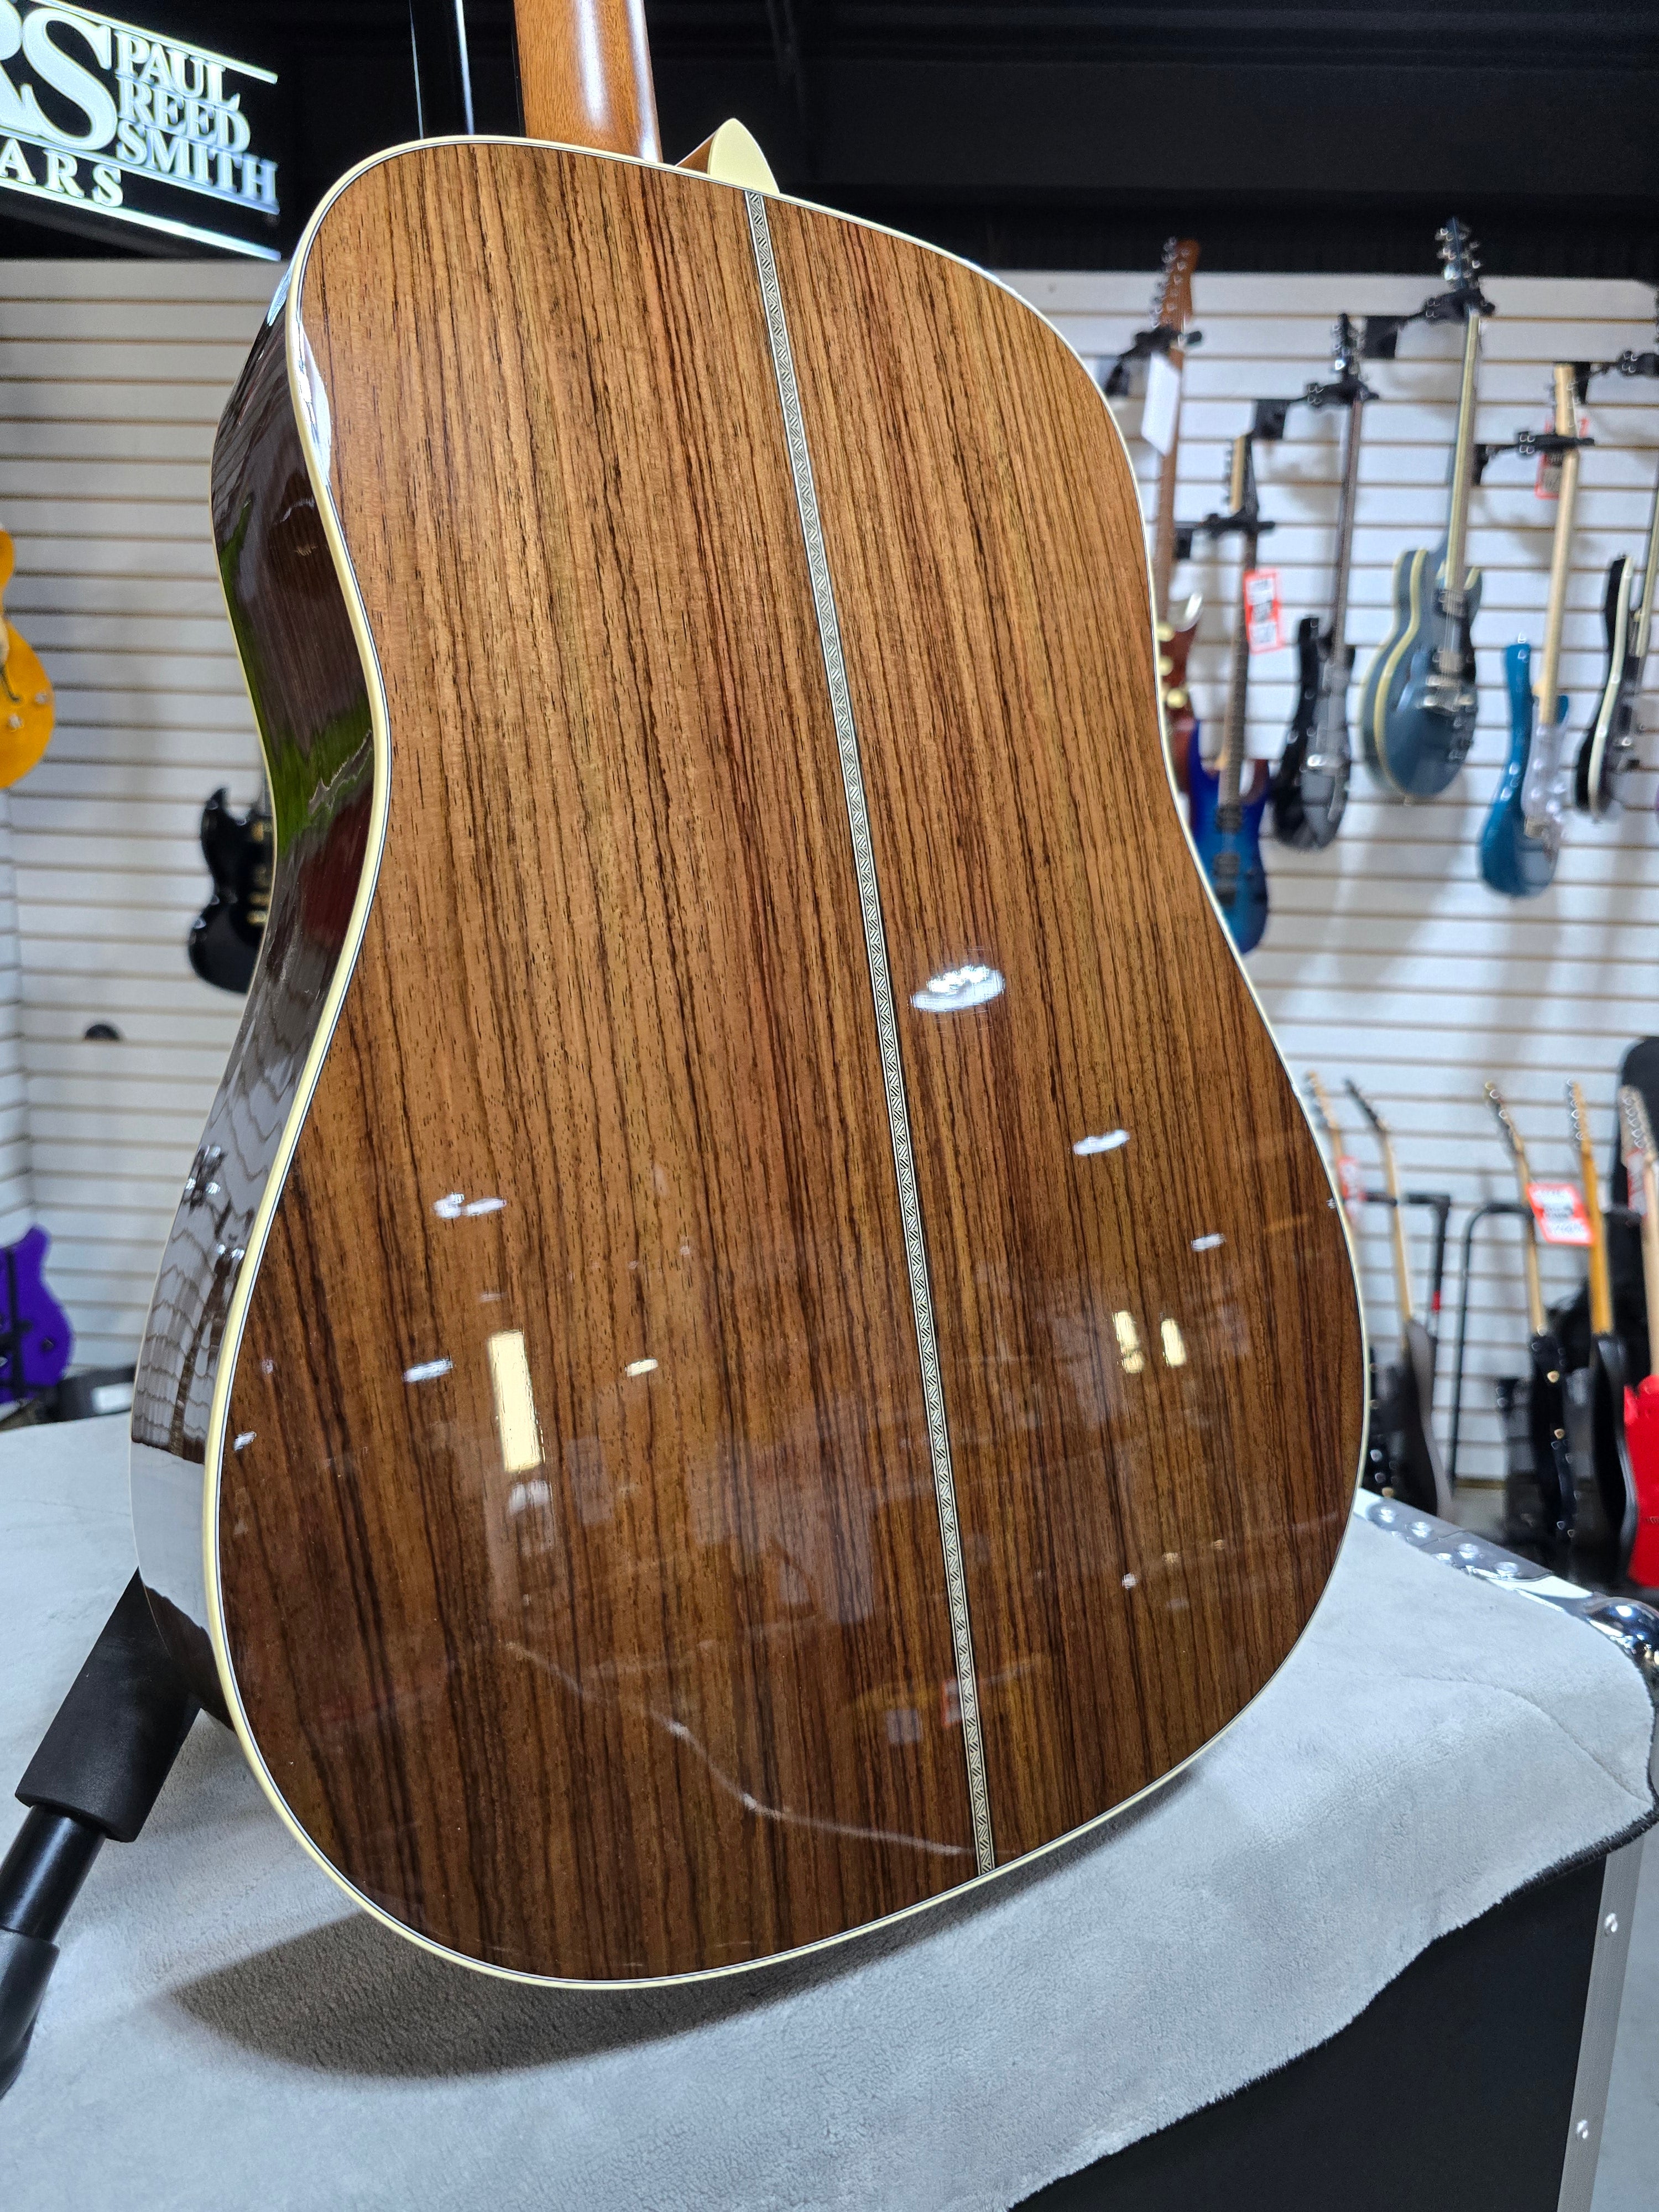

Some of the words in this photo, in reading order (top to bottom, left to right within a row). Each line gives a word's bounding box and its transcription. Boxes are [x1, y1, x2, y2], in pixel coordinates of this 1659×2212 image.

[114, 30, 241, 112] PAUL
[116, 74, 251, 153] REED
[116, 119, 278, 205] SMITH
